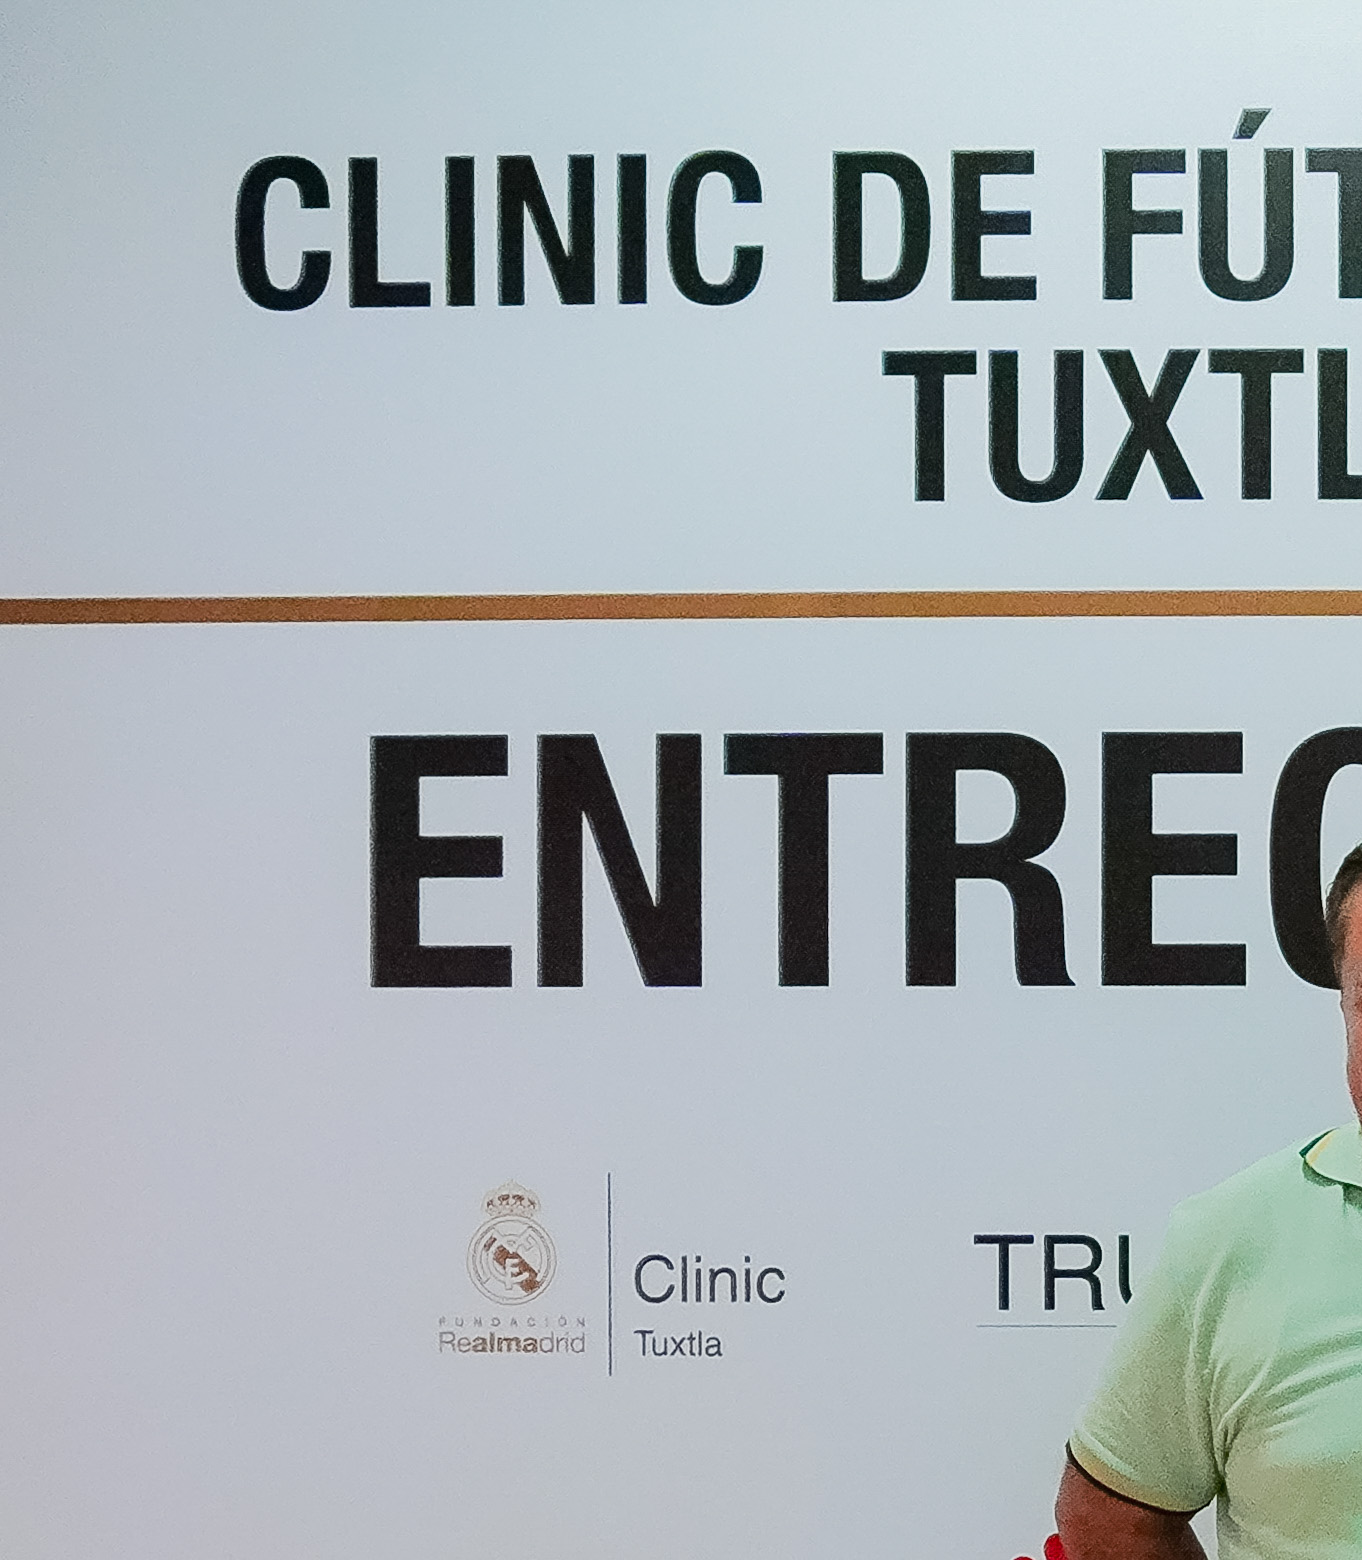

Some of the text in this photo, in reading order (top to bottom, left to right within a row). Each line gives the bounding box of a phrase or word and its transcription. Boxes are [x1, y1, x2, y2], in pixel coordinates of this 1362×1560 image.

[235, 155, 762, 310] CLINIC
[833, 150, 1037, 302] DE
[635, 1254, 785, 1303] Clinic
[439, 1315, 586, 1328] FUNDACIÓN
[440, 1332, 585, 1353] Realmadrid
[634, 1330, 722, 1357] Tuxtla
